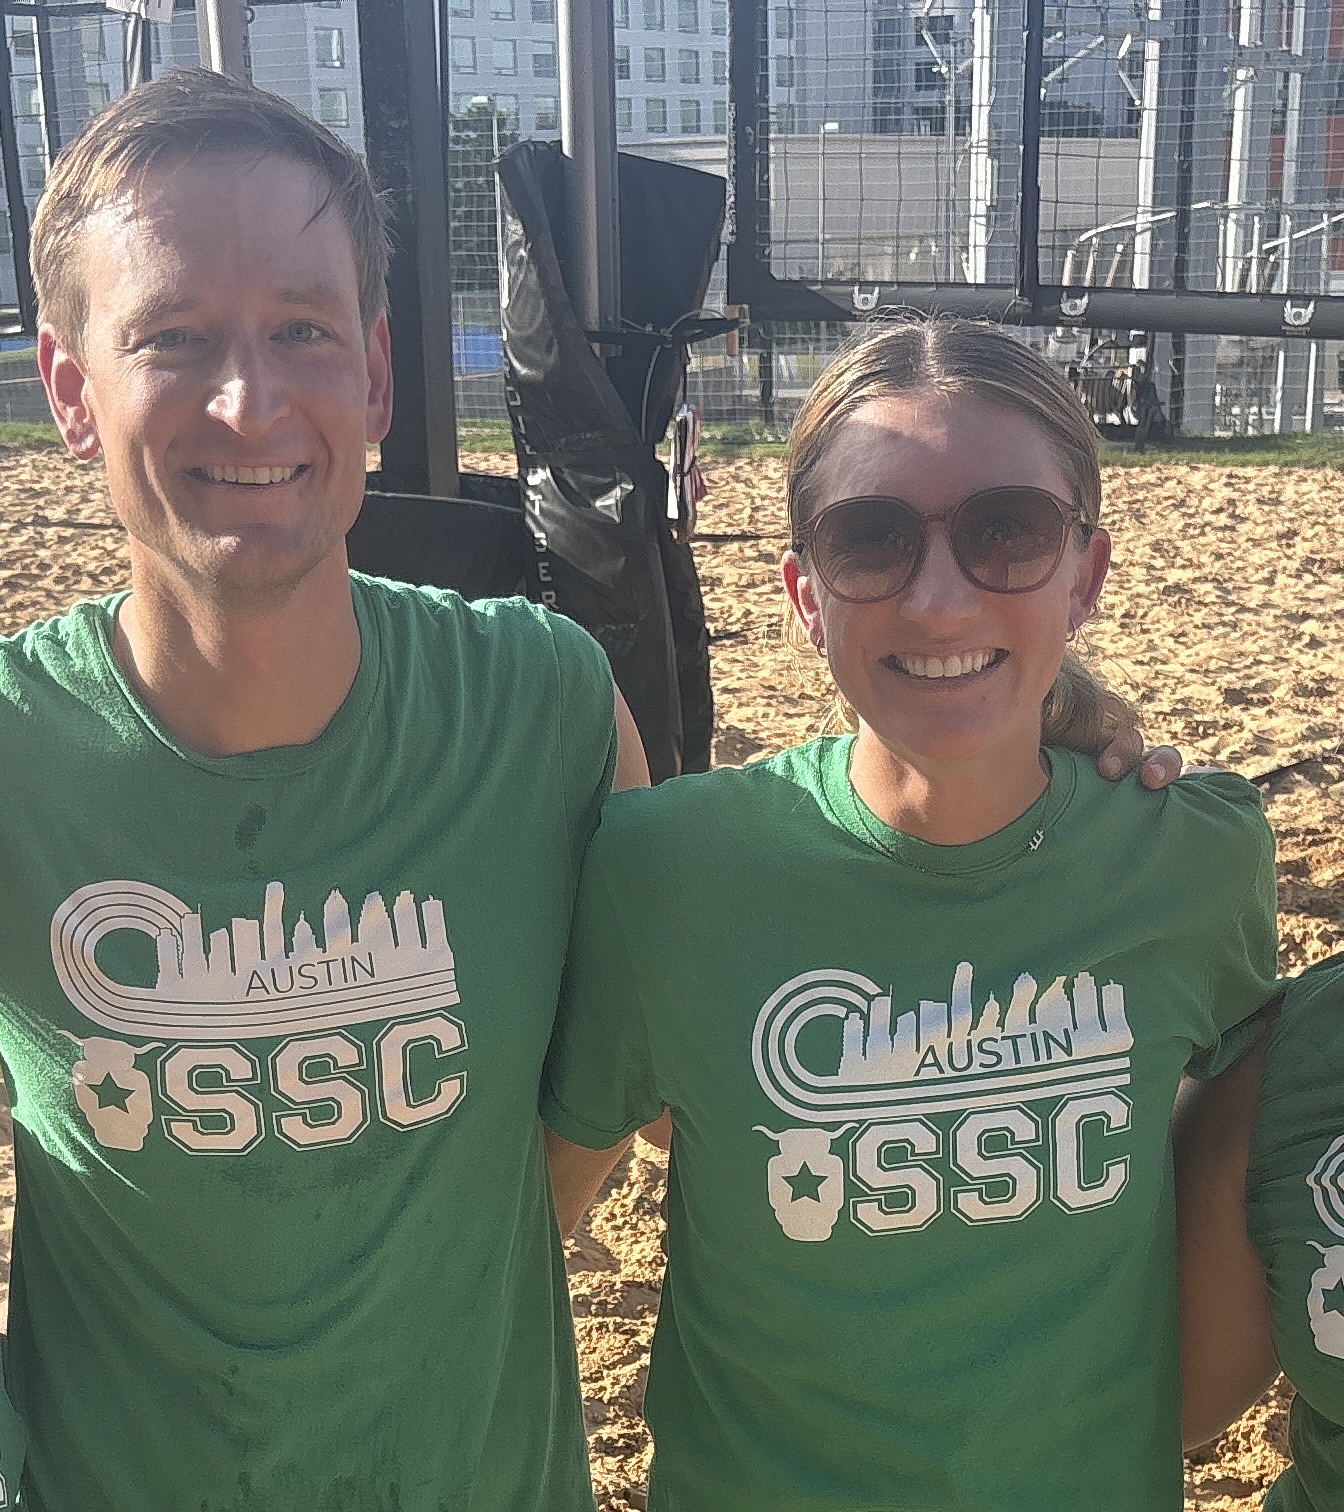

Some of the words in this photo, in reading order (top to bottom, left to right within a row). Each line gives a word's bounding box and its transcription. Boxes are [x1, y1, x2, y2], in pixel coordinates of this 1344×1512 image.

[246, 952, 375, 997] AUSTIN
[159, 1011, 468, 1156] SSC
[914, 1028, 1073, 1077] AUSTIN
[850, 1089, 1133, 1236] SSC
